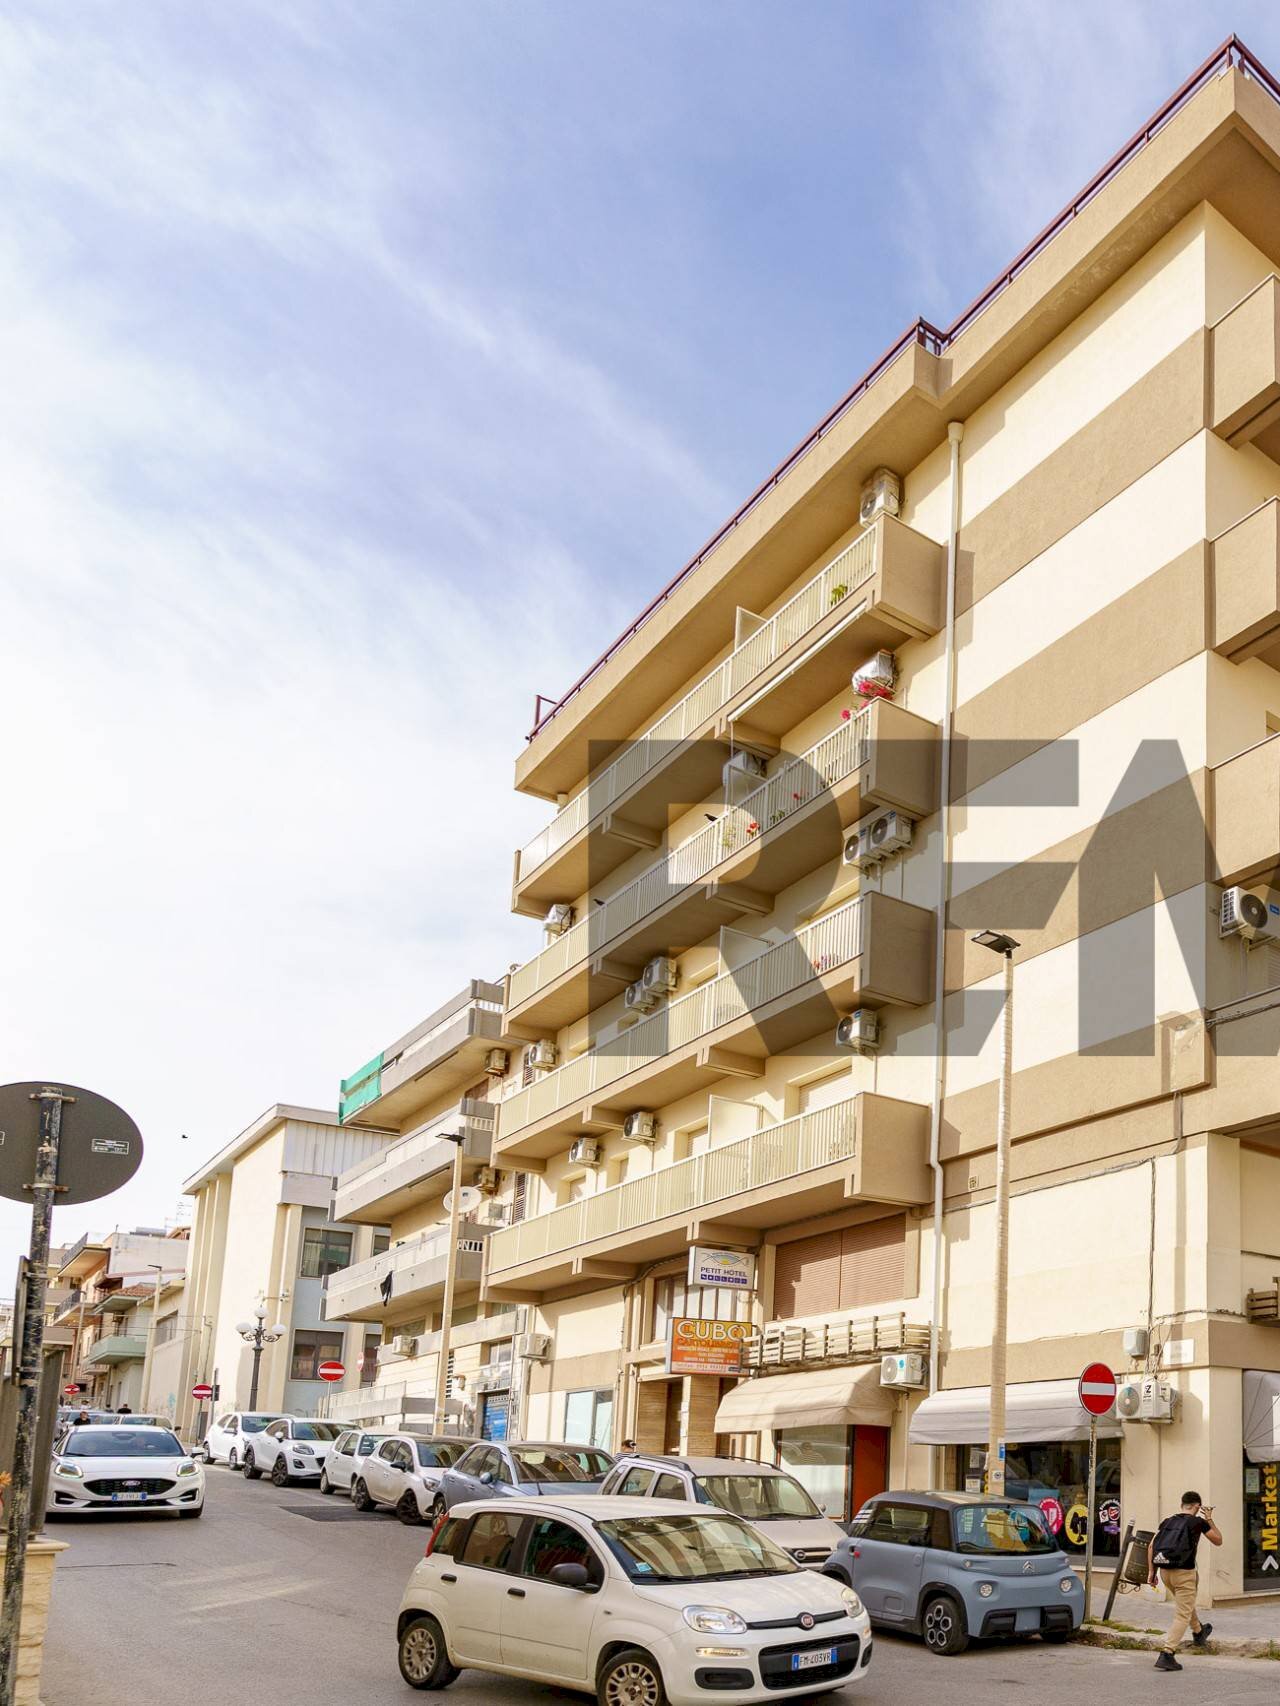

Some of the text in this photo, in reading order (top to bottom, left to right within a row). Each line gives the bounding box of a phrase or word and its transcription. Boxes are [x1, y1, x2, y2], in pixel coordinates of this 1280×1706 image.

[701, 1266, 748, 1277] PETIT HOTEL
[677, 1320, 747, 1342] CUBO
[1261, 1463, 1278, 1551] Market
